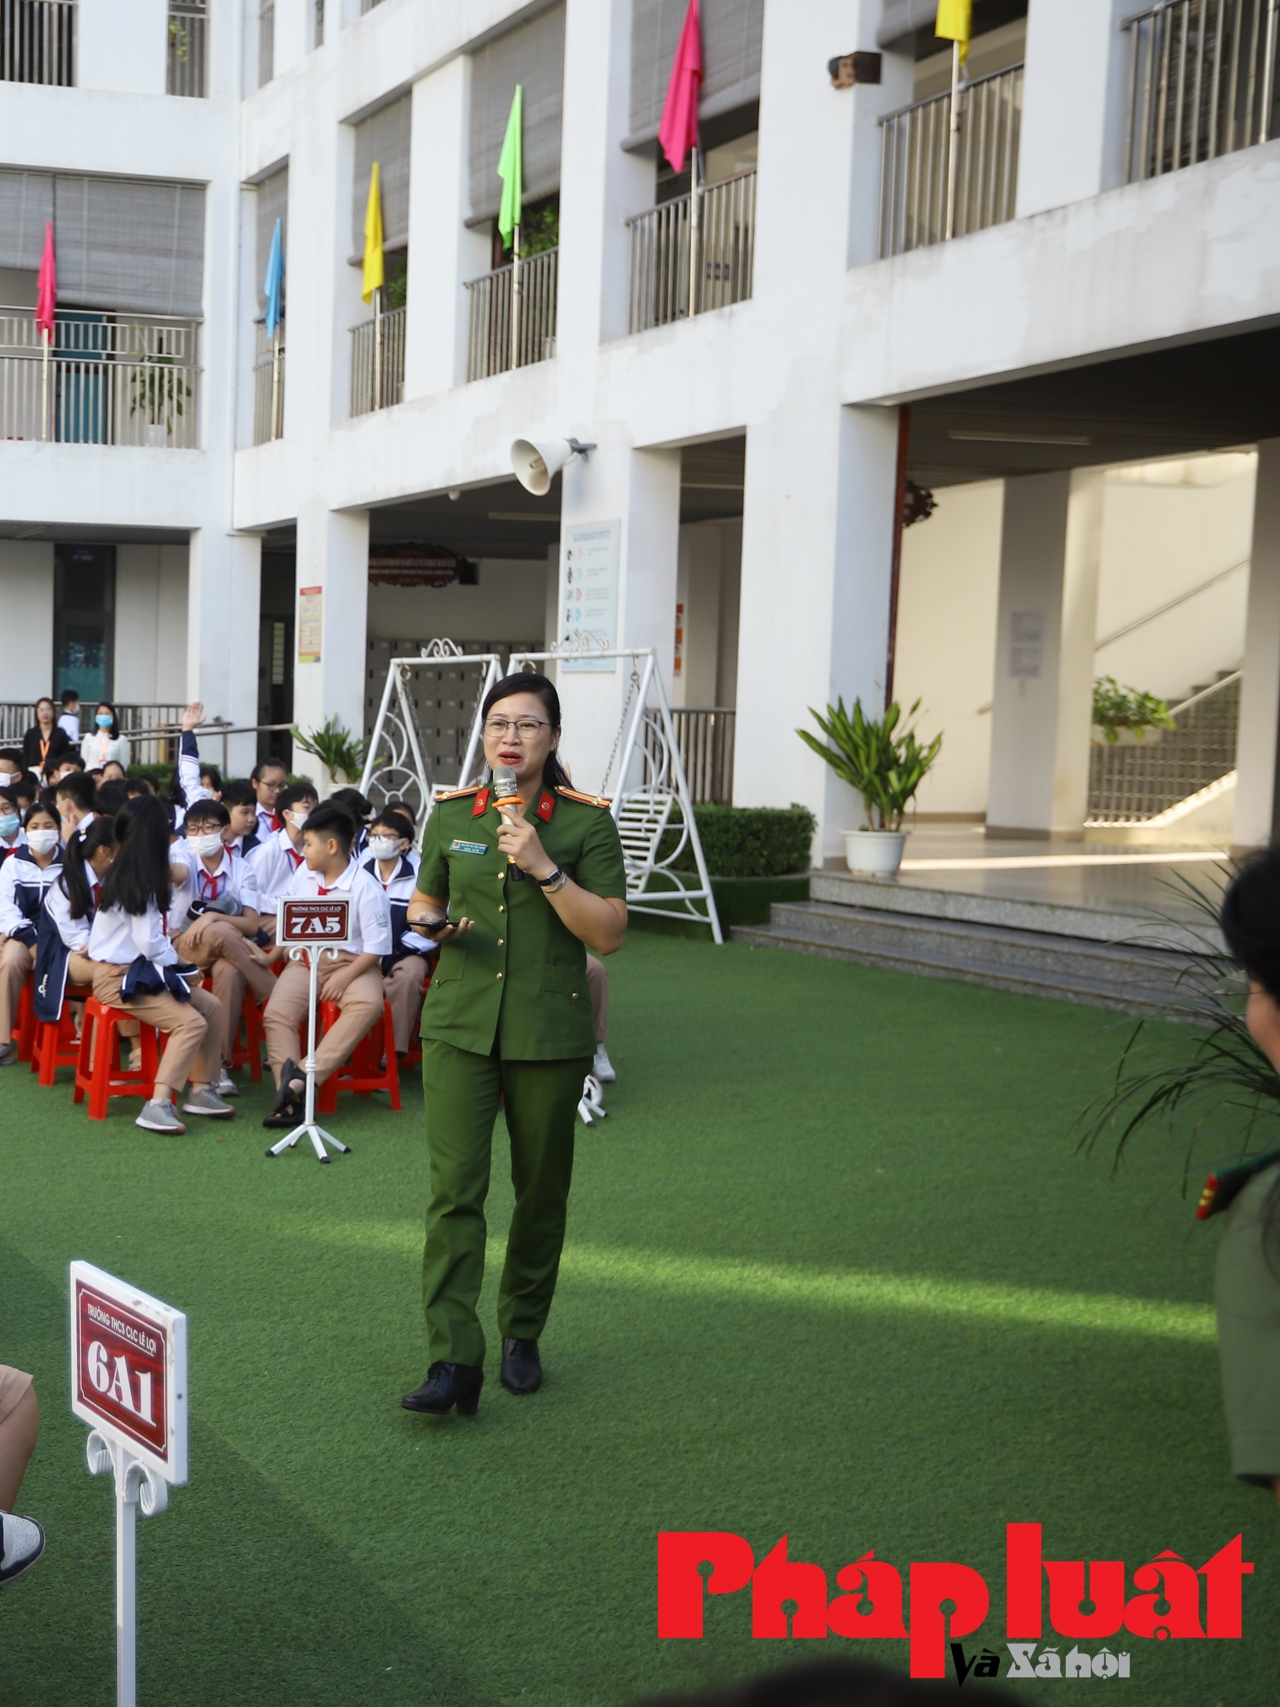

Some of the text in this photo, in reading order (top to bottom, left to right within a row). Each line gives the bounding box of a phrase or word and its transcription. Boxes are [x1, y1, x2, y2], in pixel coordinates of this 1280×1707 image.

[290, 916, 341, 934] 7A5
[87, 1303, 157, 1354] TRƯỜNG THCS CLC LÊ LỢI
[88, 1340, 157, 1427] 6A1
